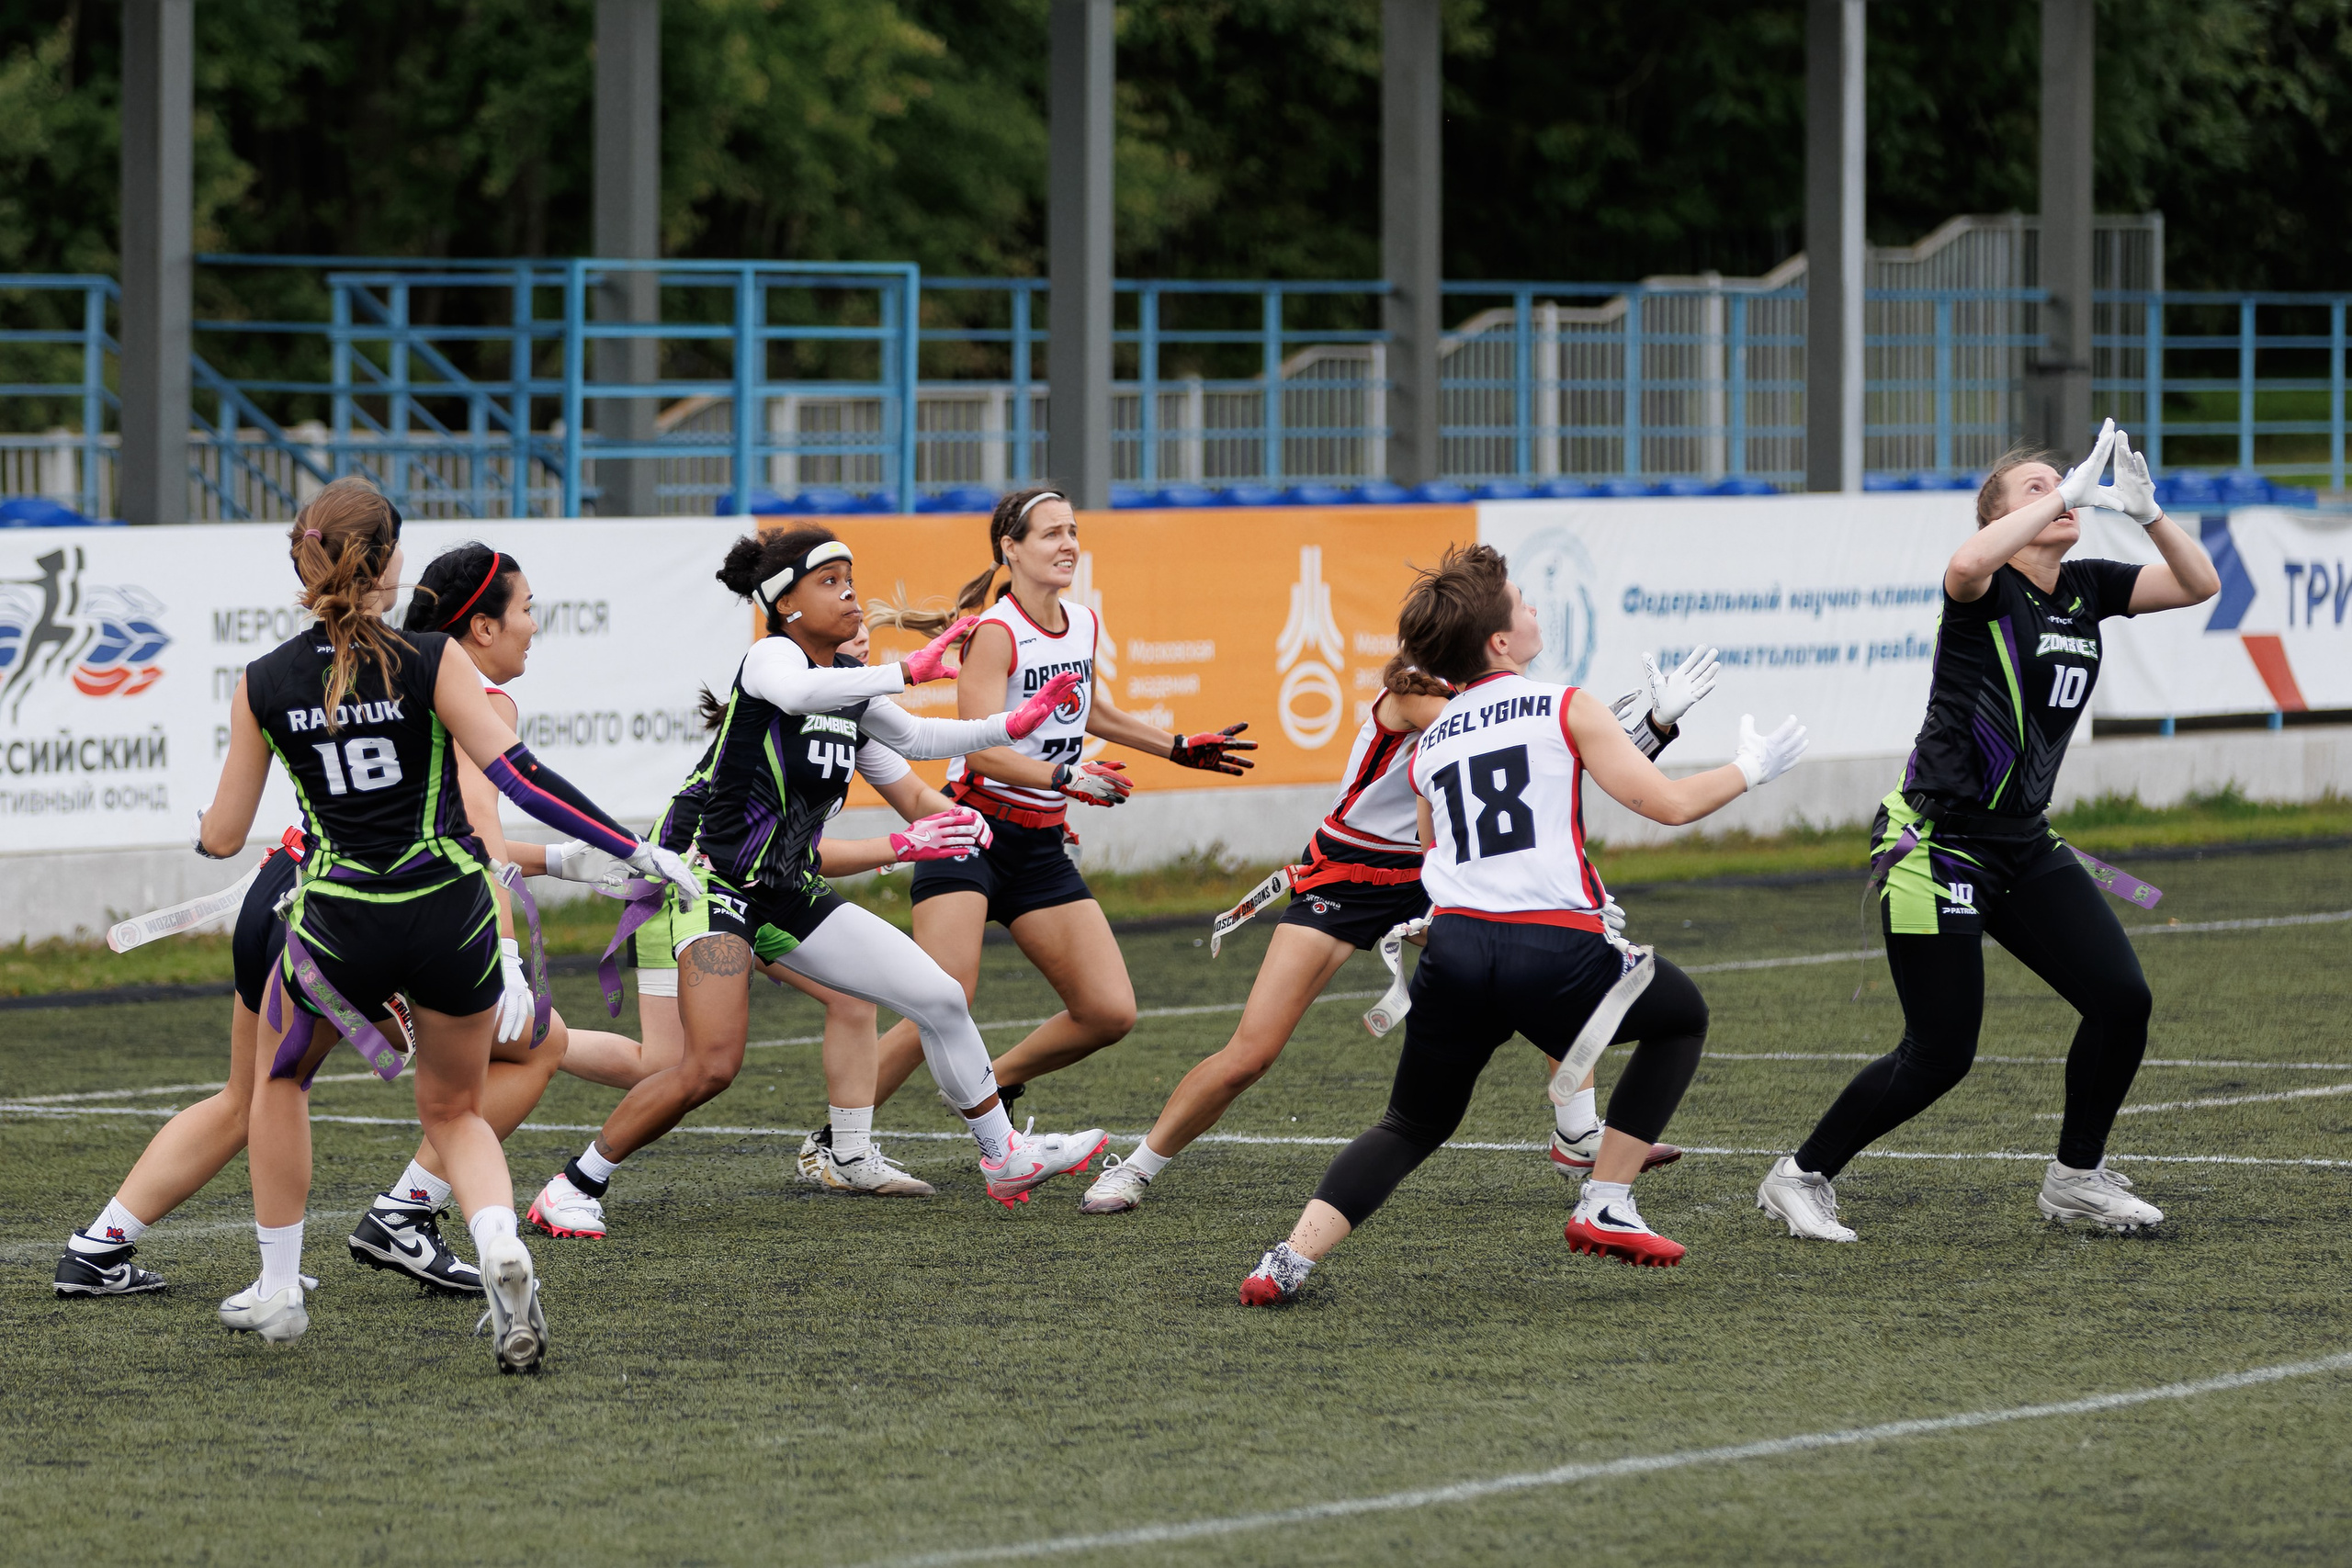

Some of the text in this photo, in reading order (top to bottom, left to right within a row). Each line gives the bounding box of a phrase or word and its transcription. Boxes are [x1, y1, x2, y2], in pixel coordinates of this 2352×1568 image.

[2036, 632, 2098, 661] ZOMBIES
[2048, 664, 2088, 708] 10
[0, 723, 168, 774] СИЙСКИЙ
[799, 713, 857, 742] ZOMBIES
[1419, 695, 1552, 759] PERELYGINA
[311, 737, 403, 795] 18
[807, 739, 855, 784] 44
[1430, 743, 1537, 866] 18
[1948, 882, 1973, 904] 10
